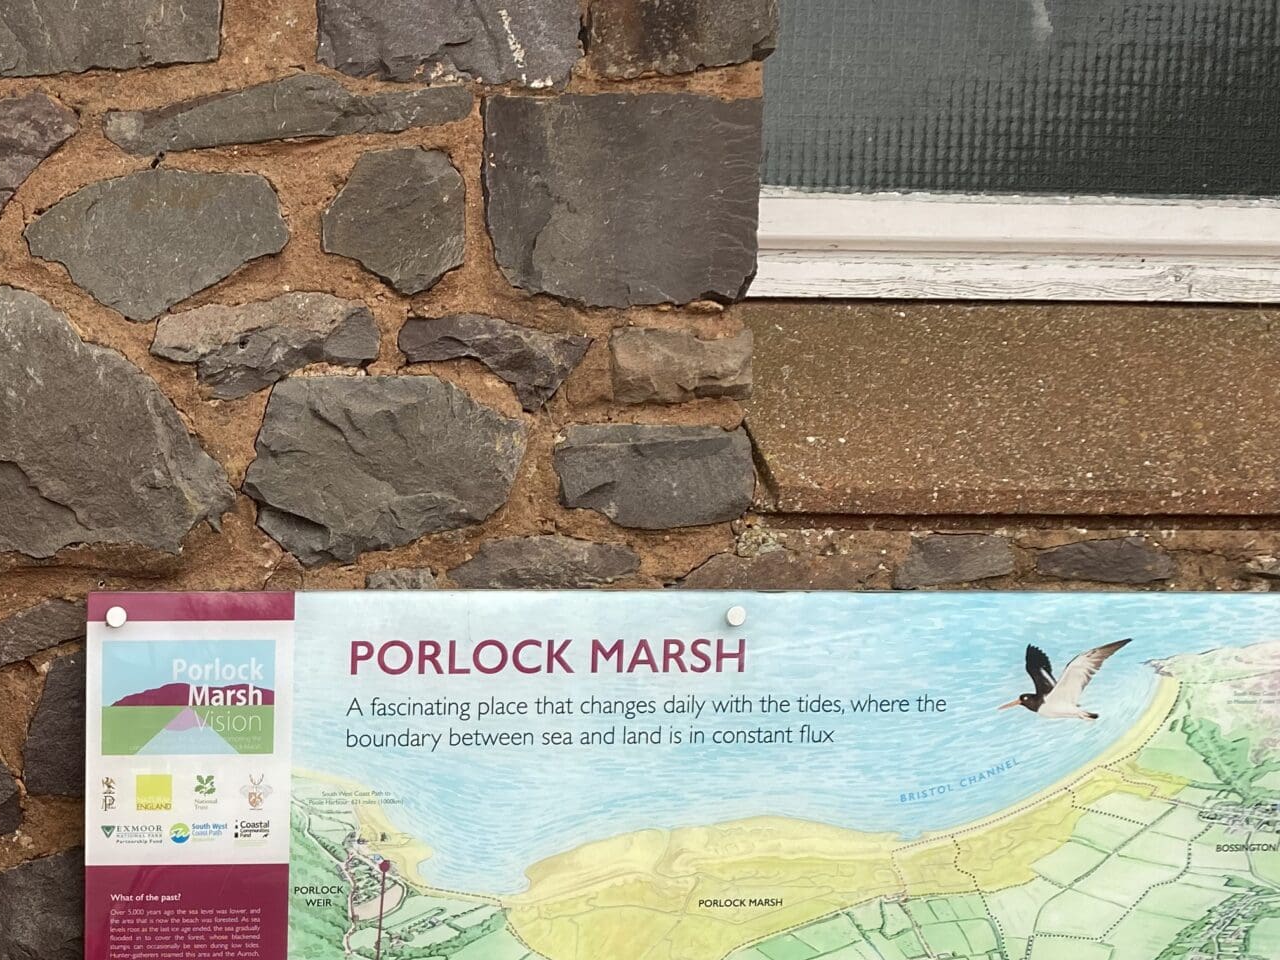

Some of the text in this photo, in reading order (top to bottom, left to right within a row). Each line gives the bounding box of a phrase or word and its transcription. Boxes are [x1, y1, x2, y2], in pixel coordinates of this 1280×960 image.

[349, 638, 747, 675] PORLOCK MARSH
[172, 658, 264, 680] Porlock
[188, 685, 263, 706] Marsh
[346, 693, 947, 720] A fascinating place that changes daily with the tides, where the
[194, 710, 262, 732] Vision
[346, 725, 834, 752] boundary between sea and land is in constant flux
[899, 758, 1021, 804] BRISTOL CHANNEL
[137, 803, 171, 811] ENGLAND
[240, 820, 270, 829] Coastal
[1215, 843, 1277, 853] BOSSINGTON
[294, 885, 344, 895] PORLOCK
[135, 893, 145, 901] of
[145, 893, 159, 901] the
[161, 893, 181, 903] past?
[305, 898, 332, 907] WEIR
[698, 898, 783, 908] PORLOCK MARSH
